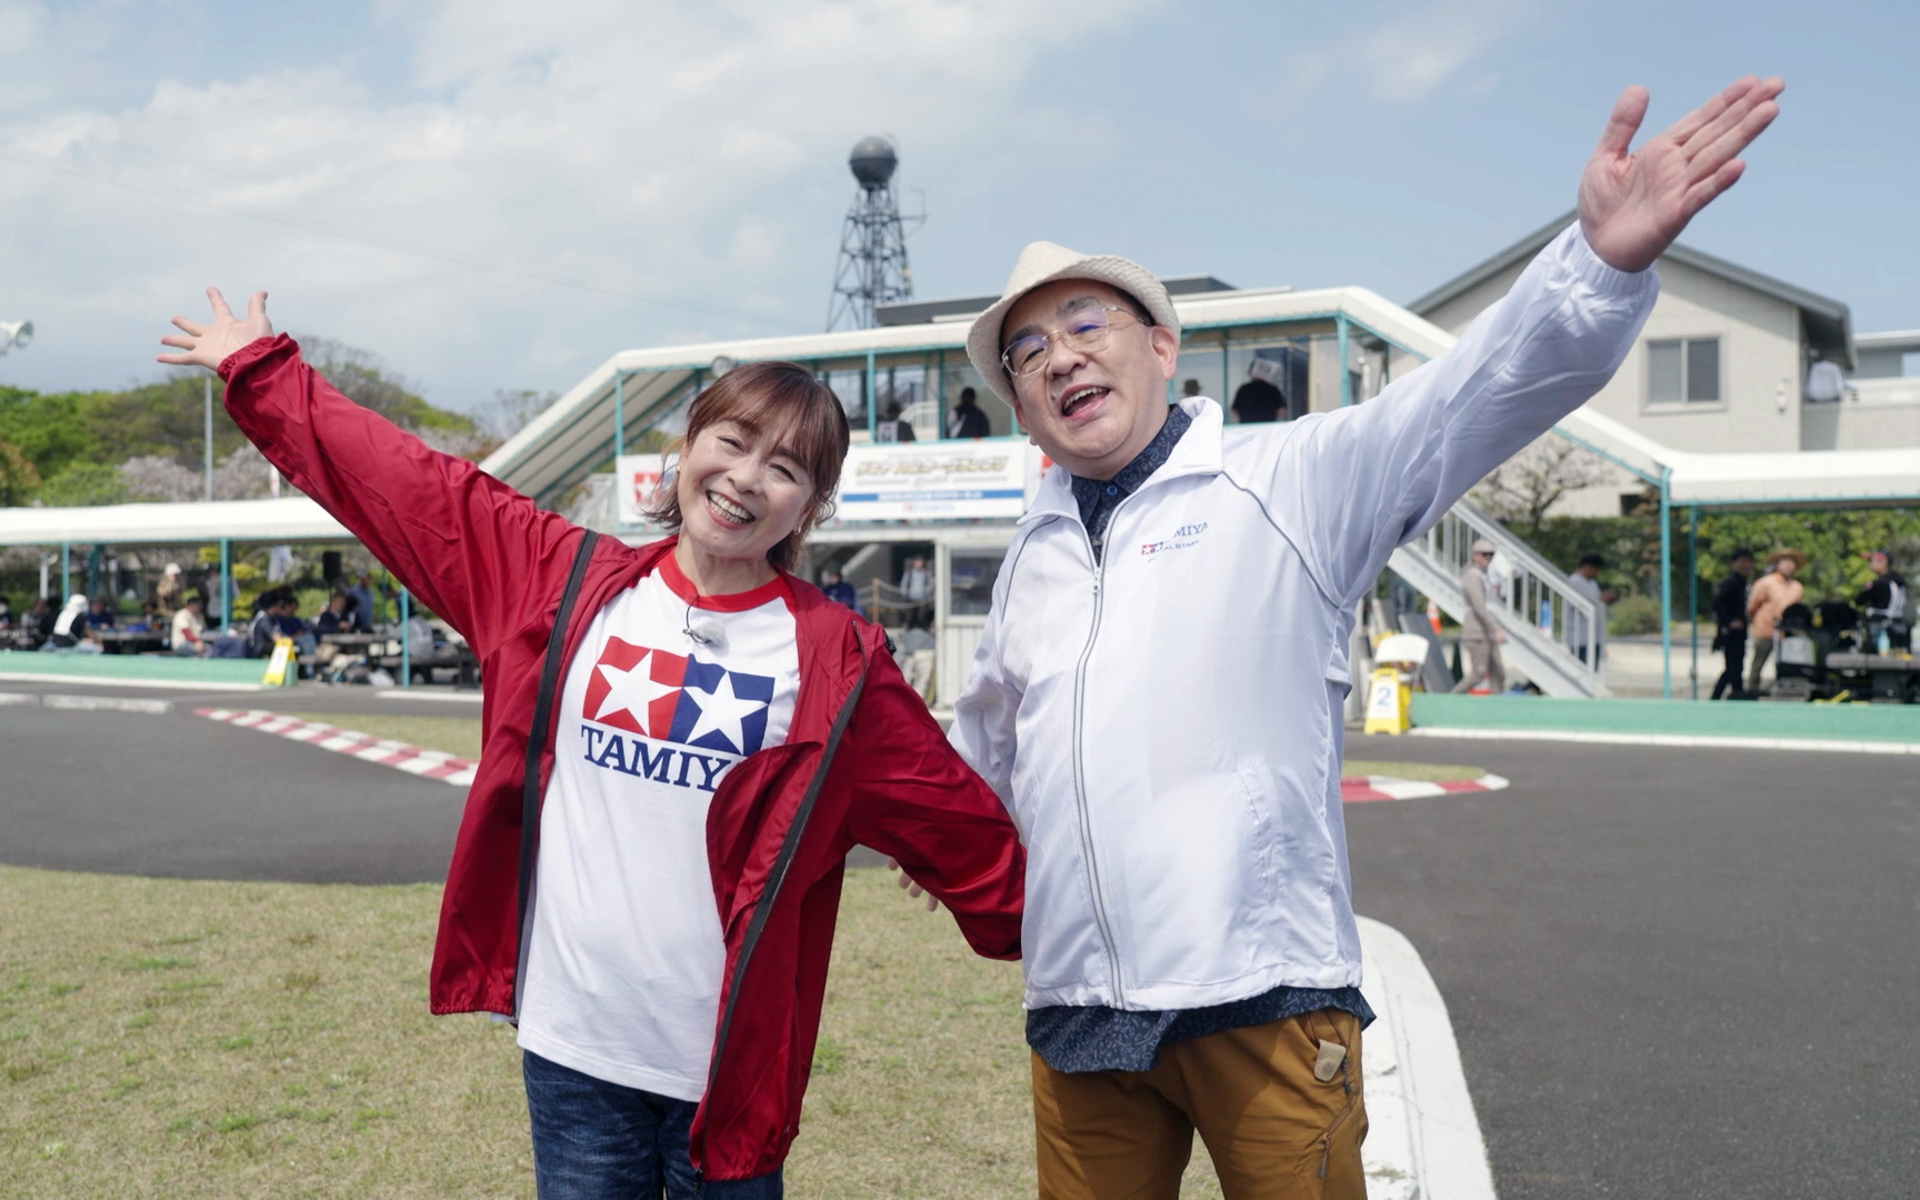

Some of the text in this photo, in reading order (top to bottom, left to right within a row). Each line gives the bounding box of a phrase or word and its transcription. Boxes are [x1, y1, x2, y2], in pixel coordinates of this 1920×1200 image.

[1170, 521, 1208, 539] MIYA
[1377, 686, 1391, 706] 2
[581, 724, 731, 793] TAMIY
